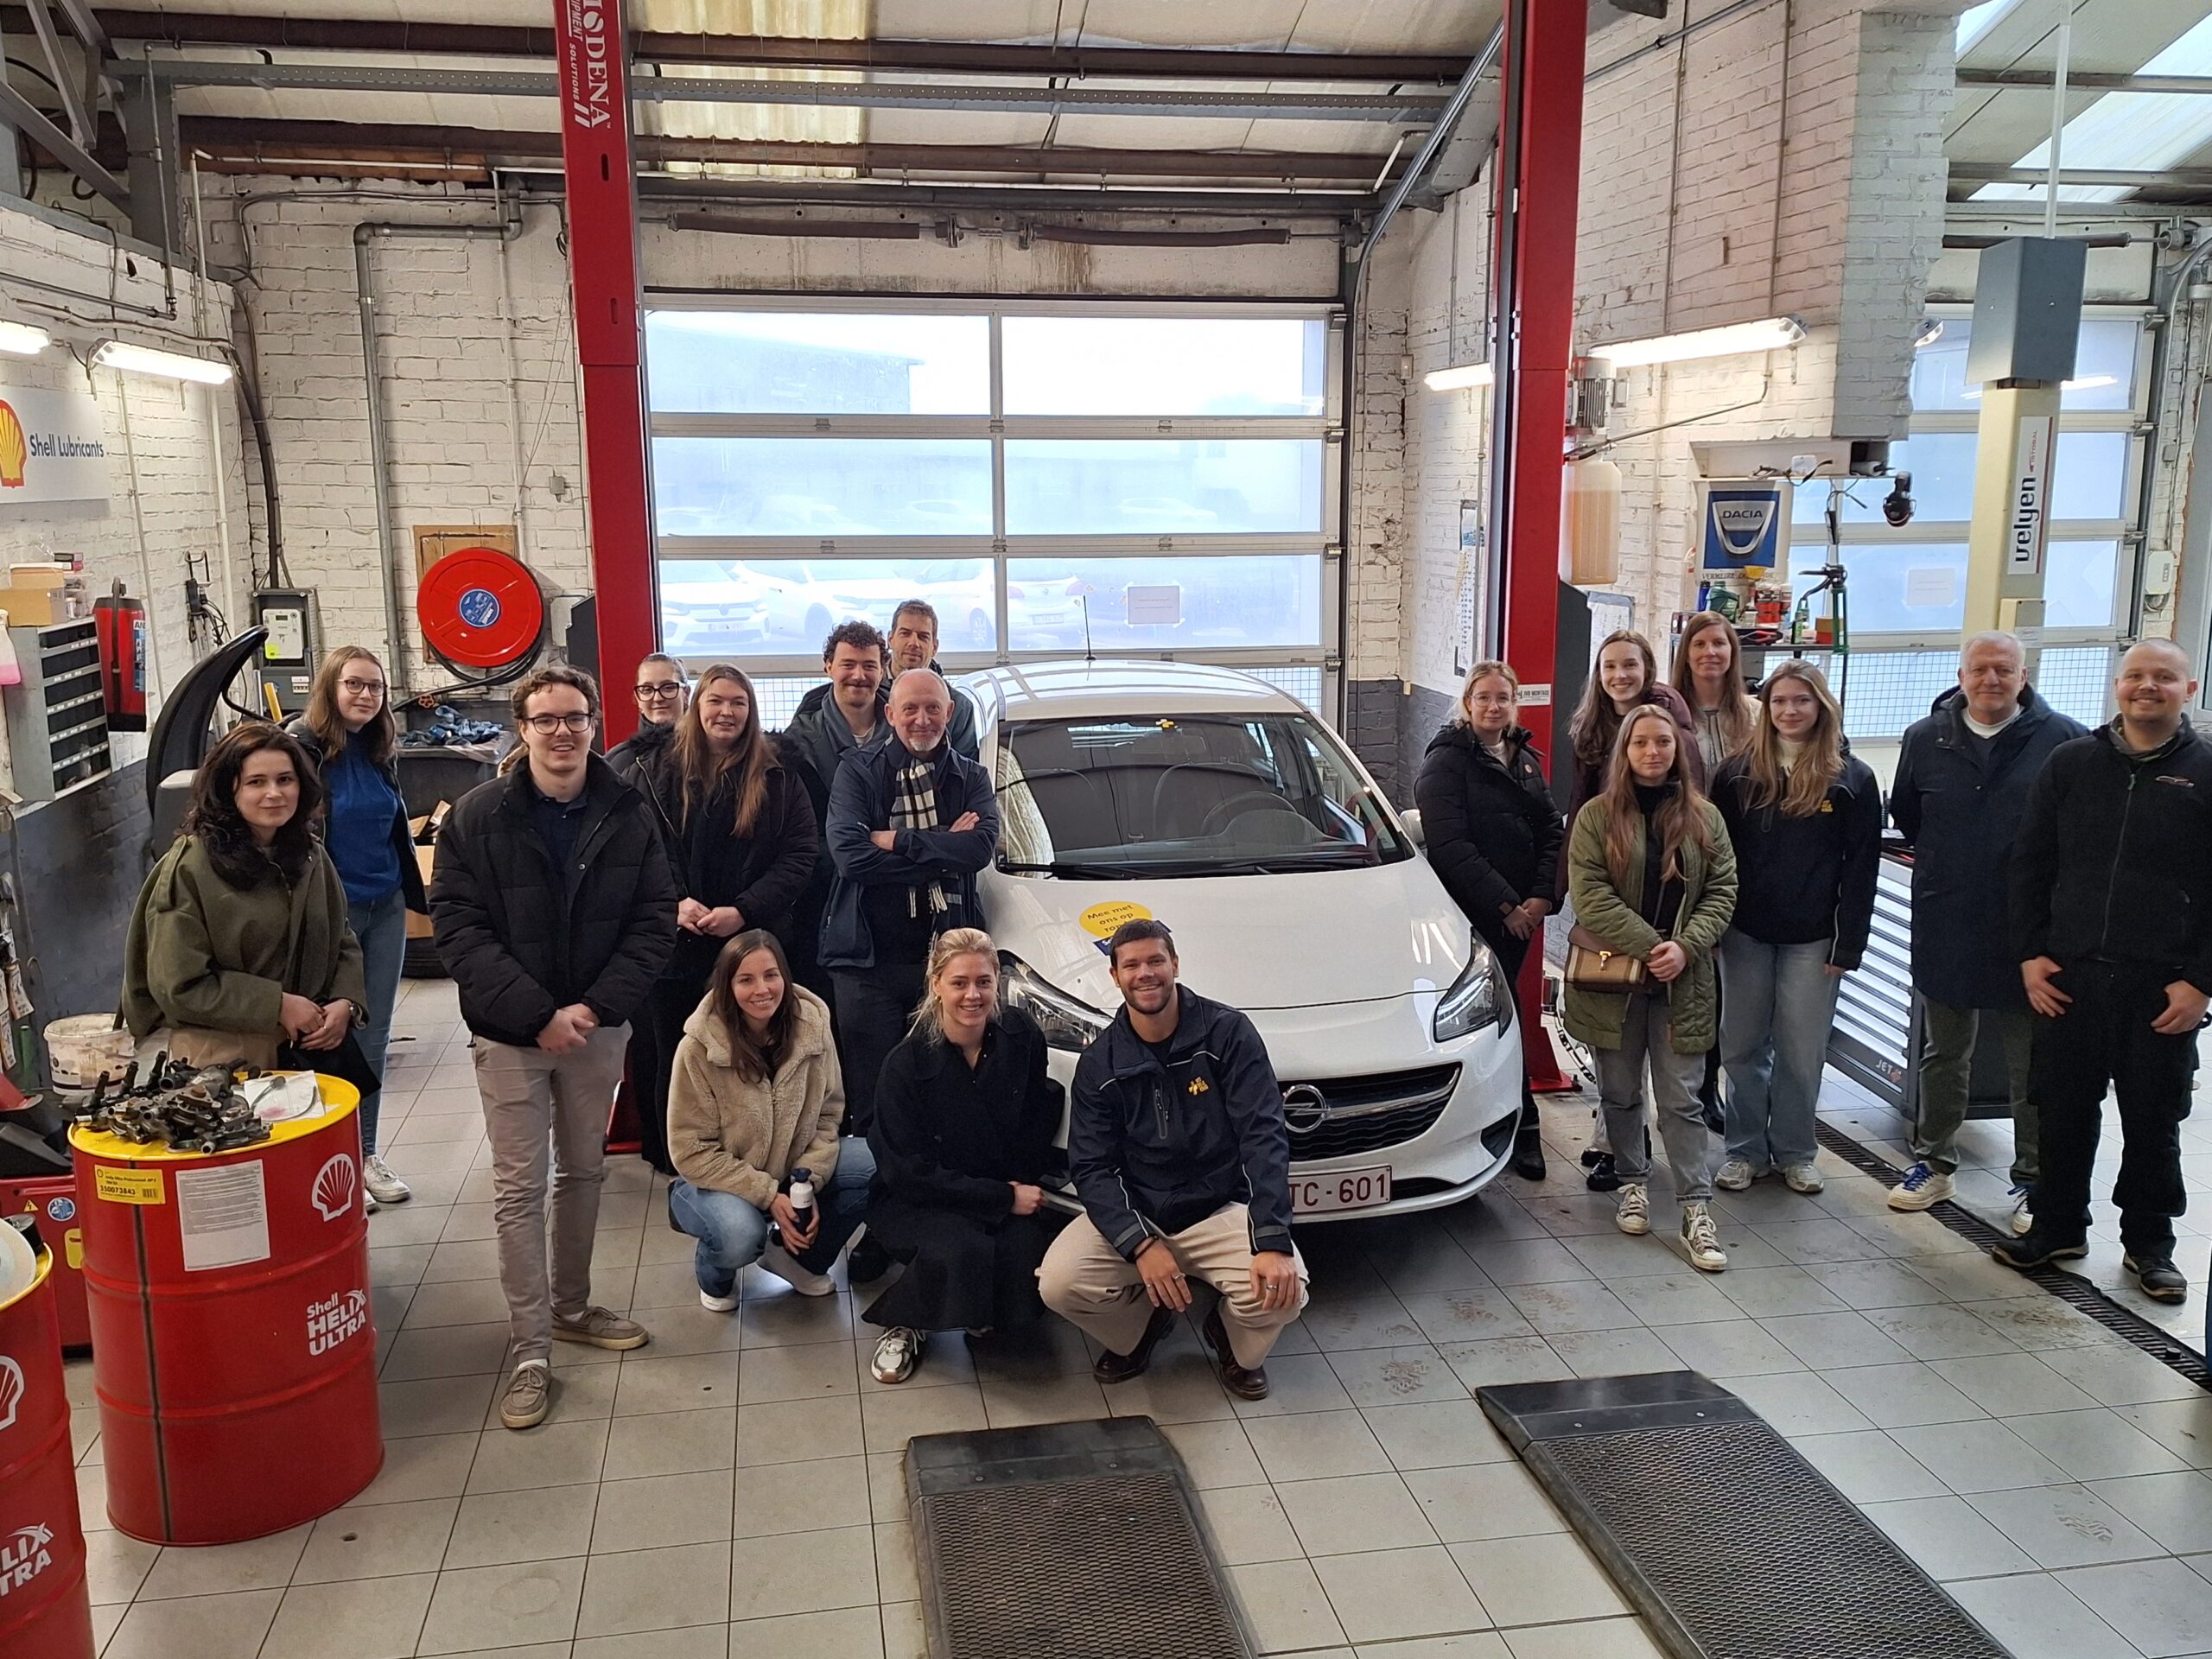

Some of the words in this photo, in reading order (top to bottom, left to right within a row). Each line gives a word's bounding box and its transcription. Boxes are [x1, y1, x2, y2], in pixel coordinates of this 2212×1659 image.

[569, 43, 580, 101] SOLUTIONS
[29, 433, 56, 457] Shell
[58, 435, 105, 458] Lubricants
[1722, 510, 1763, 519] DACIA
[2013, 476, 2040, 563] velyen
[1087, 911, 1110, 920] Mee
[1112, 904, 1134, 913] met
[1099, 916, 1118, 925] ons
[1875, 1058, 1893, 1075] JET
[307, 1292, 339, 1319] Shell
[307, 1288, 367, 1339] HELIX
[309, 1309, 366, 1357] ULTRA
